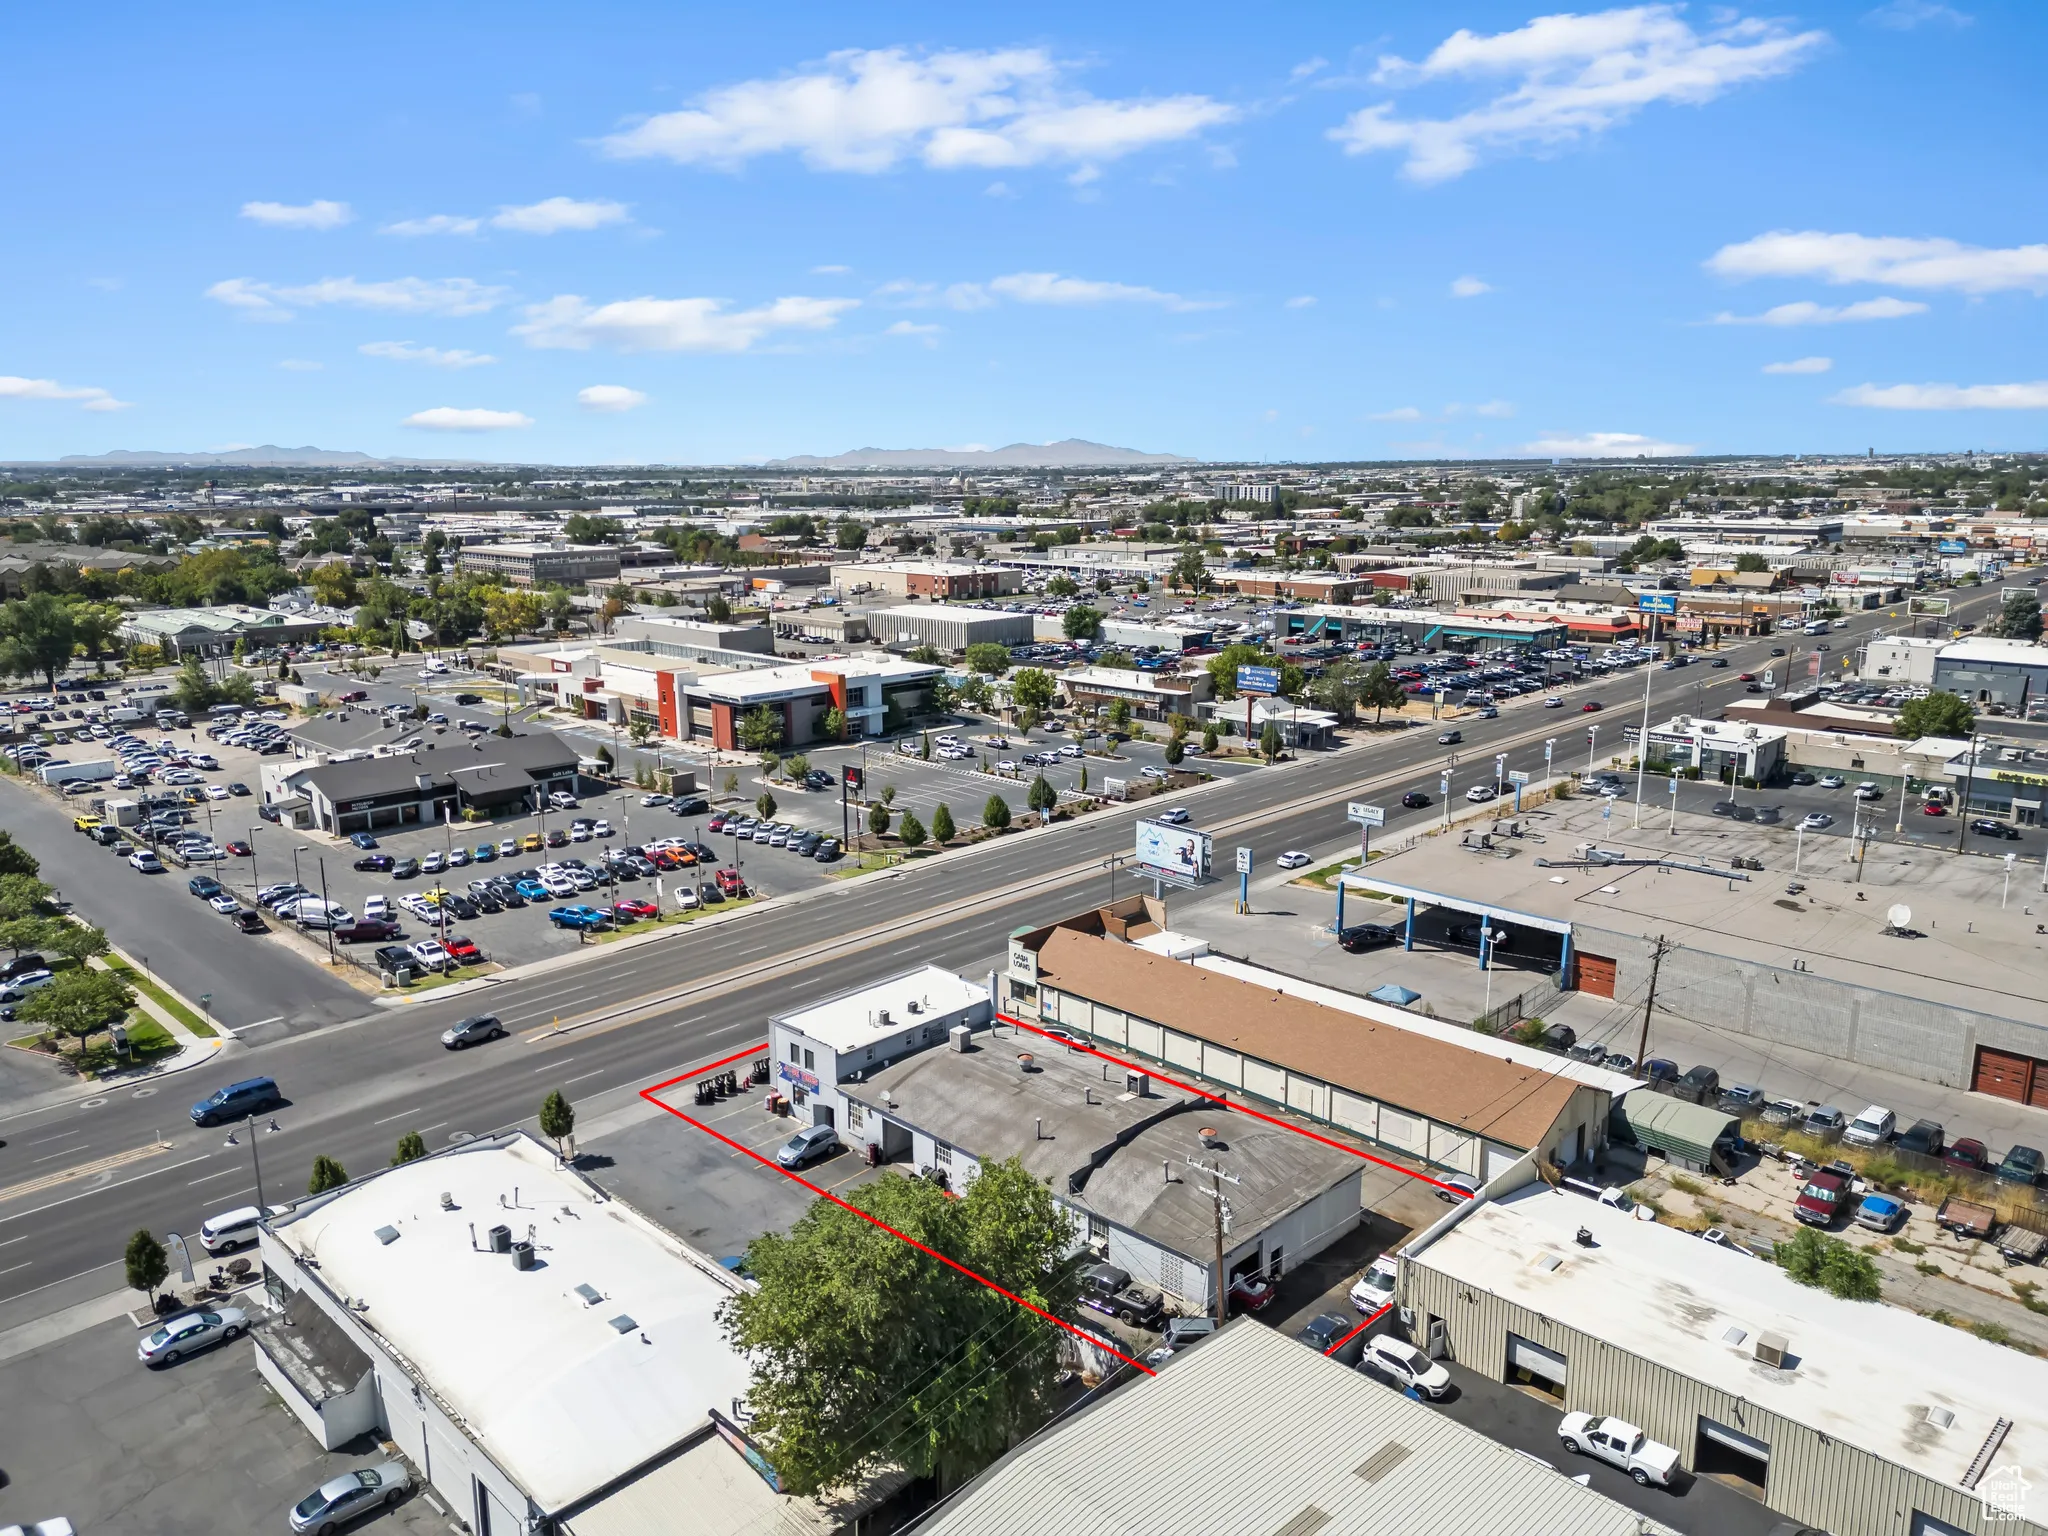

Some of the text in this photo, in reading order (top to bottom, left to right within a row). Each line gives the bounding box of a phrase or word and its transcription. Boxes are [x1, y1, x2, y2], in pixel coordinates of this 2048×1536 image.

[1363, 806, 1379, 815] LEGACY
[1013, 952, 1029, 963] CASH
[1013, 959, 1031, 972] LOANS
